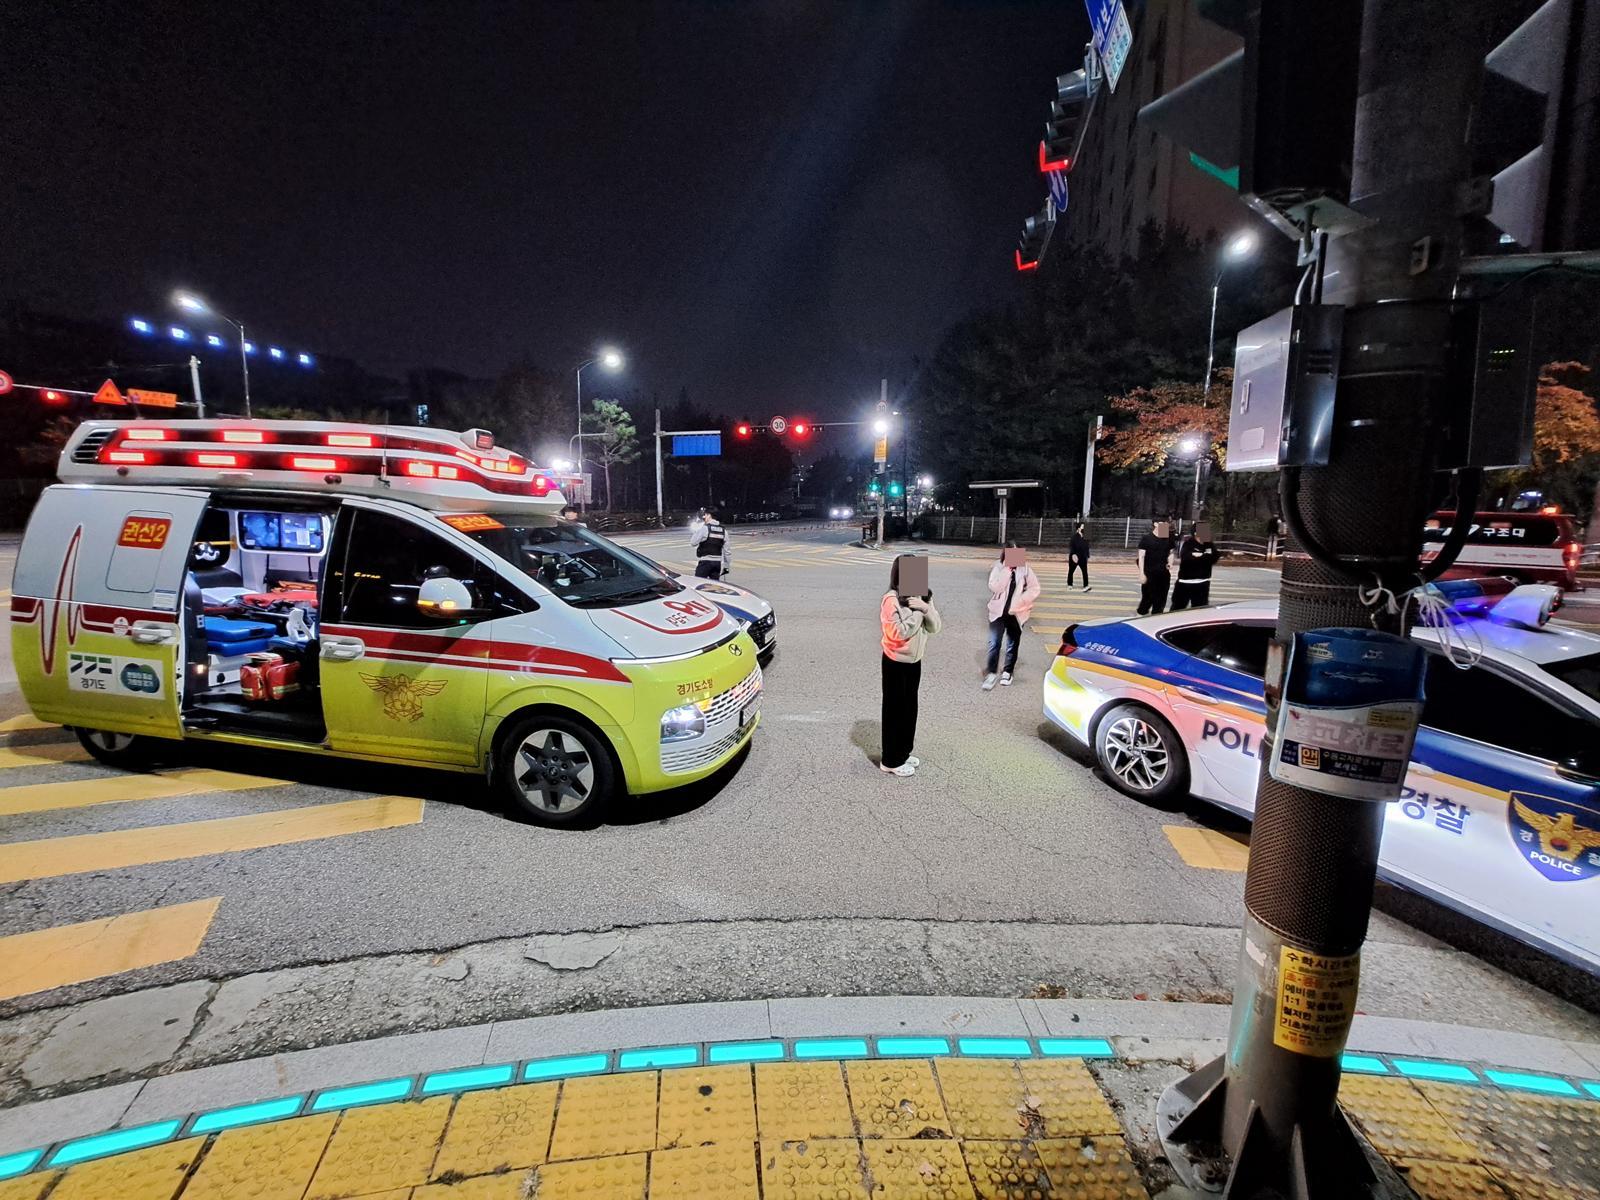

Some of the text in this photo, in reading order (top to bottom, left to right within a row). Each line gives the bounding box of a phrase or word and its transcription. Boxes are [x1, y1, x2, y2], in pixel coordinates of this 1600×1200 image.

[773, 420, 785, 430] 30
[122, 521, 167, 543] 권선2
[1483, 526, 1526, 538] 구조대
[80, 677, 106, 690] 경기도
[677, 678, 714, 697] 경기도소방
[1400, 786, 1471, 835] 경찰
[1530, 850, 1583, 877] POLICE
[1285, 995, 1300, 1006] 1:1
